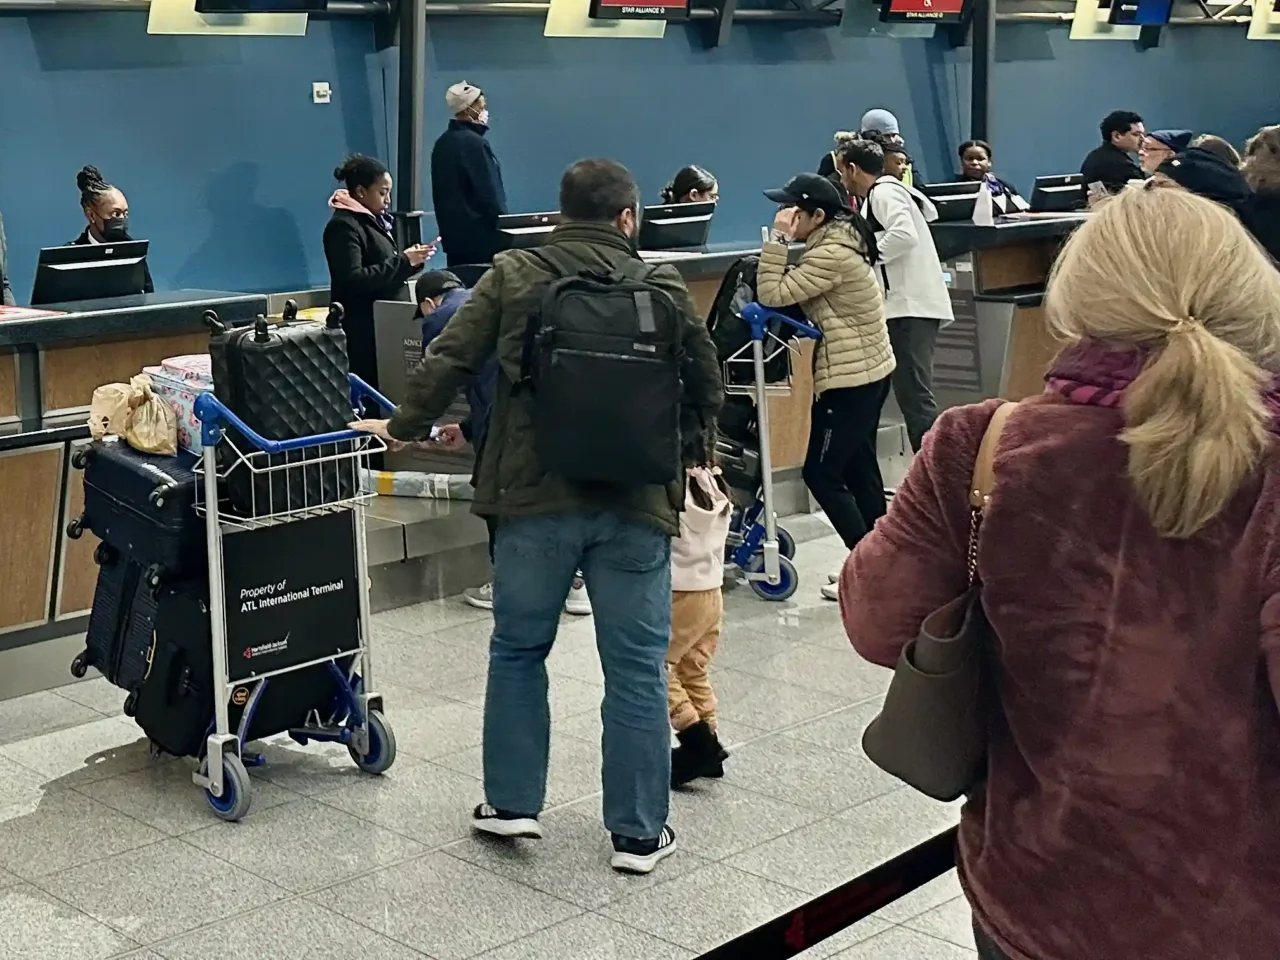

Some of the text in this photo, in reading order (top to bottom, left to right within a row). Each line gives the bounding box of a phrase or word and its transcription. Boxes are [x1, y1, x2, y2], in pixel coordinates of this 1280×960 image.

[240, 579, 287, 599] Property of
[241, 579, 344, 613] ATL International Terminal
